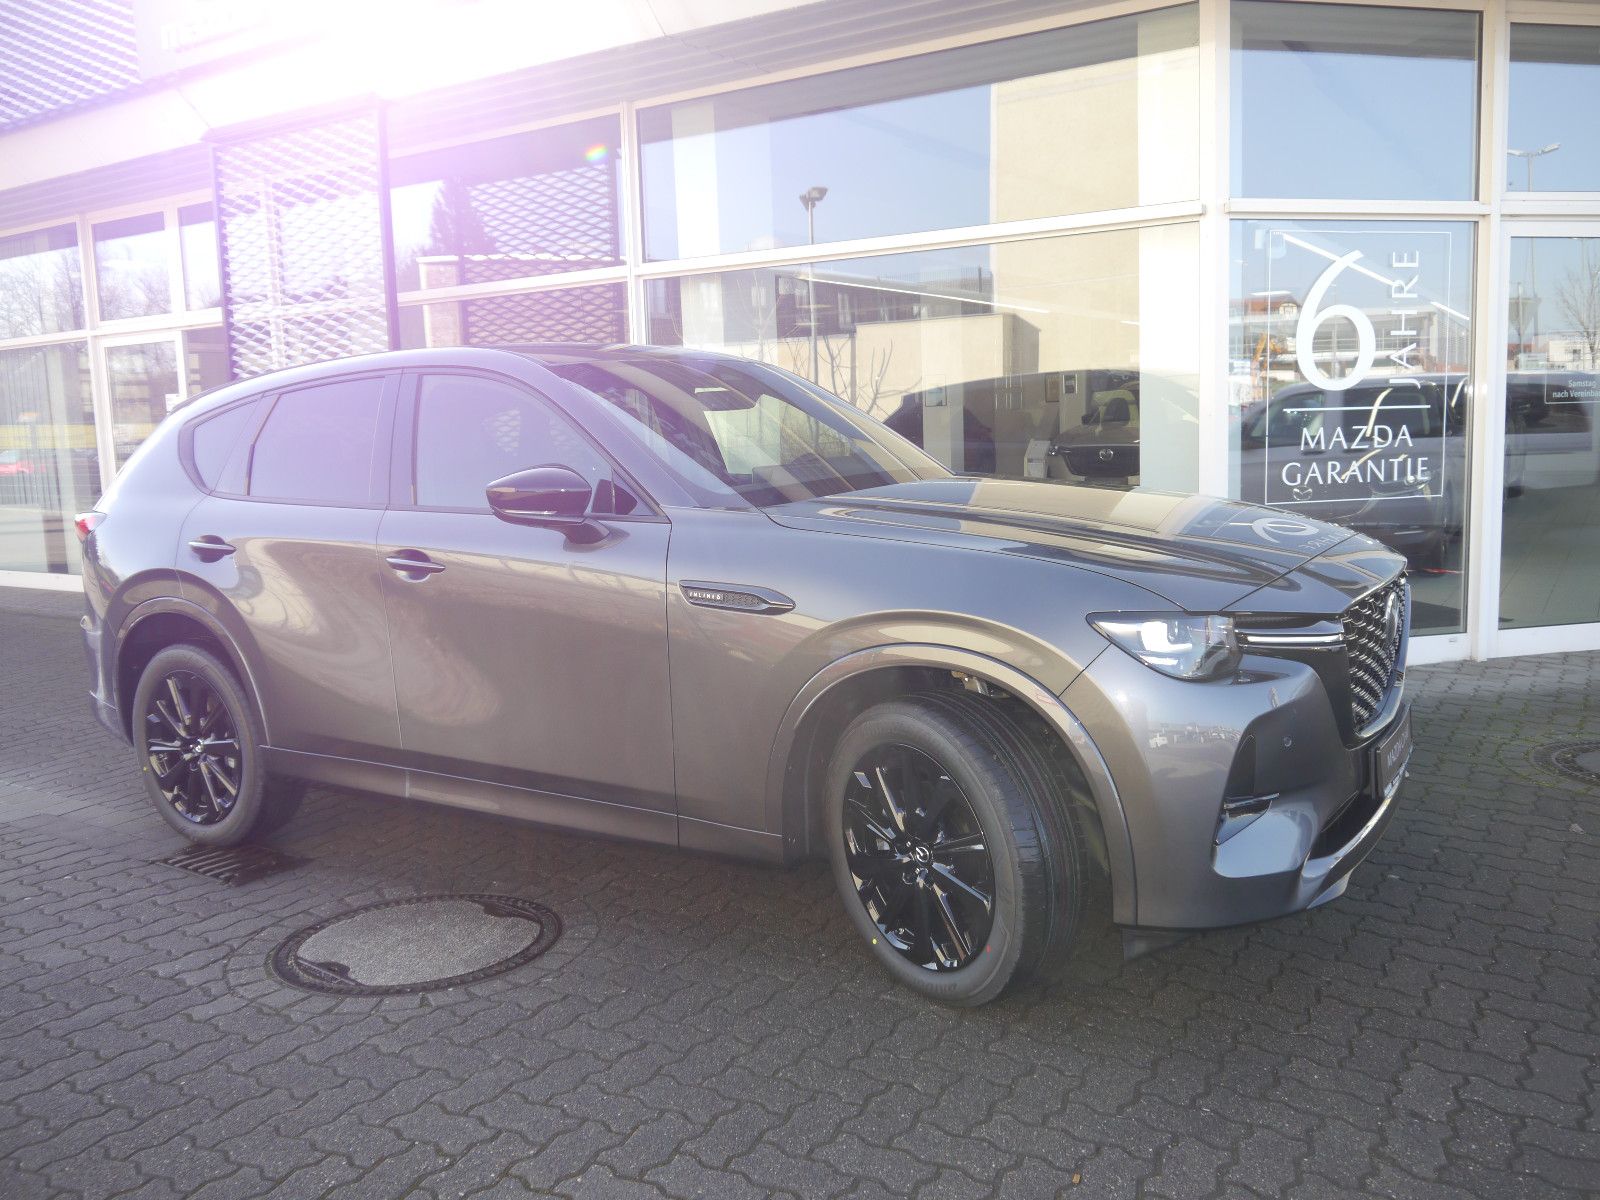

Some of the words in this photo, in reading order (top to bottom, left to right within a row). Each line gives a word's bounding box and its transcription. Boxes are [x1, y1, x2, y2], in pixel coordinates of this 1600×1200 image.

[1296, 249, 1376, 391] 6
[1389, 250, 1421, 389] JAHRE
[1552, 390, 1569, 398] nach
[1568, 380, 1596, 389] Samstag
[1301, 424, 1414, 451] MAZDA
[1281, 457, 1429, 486] GARANTIE
